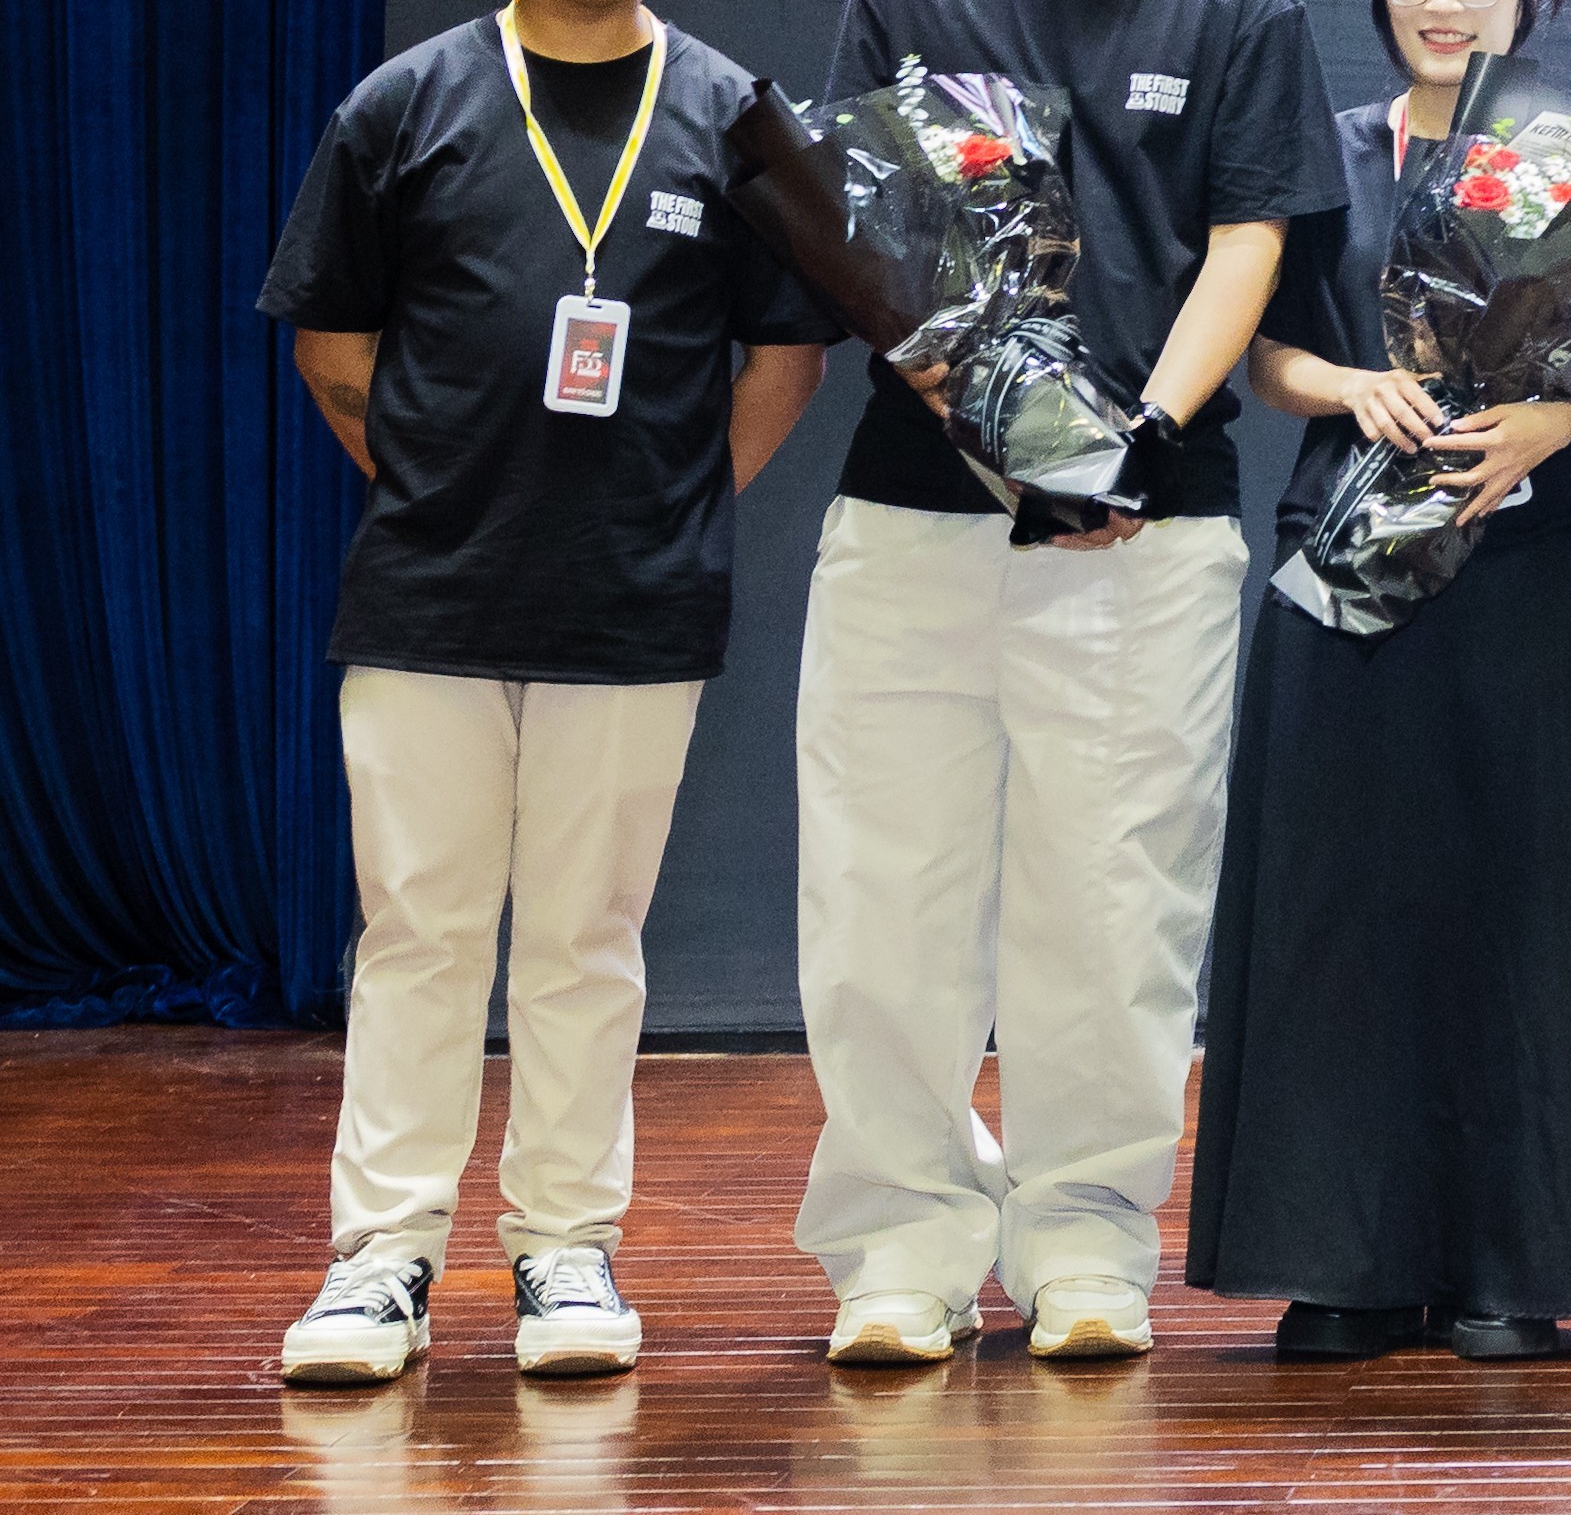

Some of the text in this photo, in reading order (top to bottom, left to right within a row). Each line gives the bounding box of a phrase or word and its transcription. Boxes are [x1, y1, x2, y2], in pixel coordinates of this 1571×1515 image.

[1129, 73, 1190, 97] THE FIRST
[1144, 91, 1187, 115] STORY
[650, 191, 677, 213] THE
